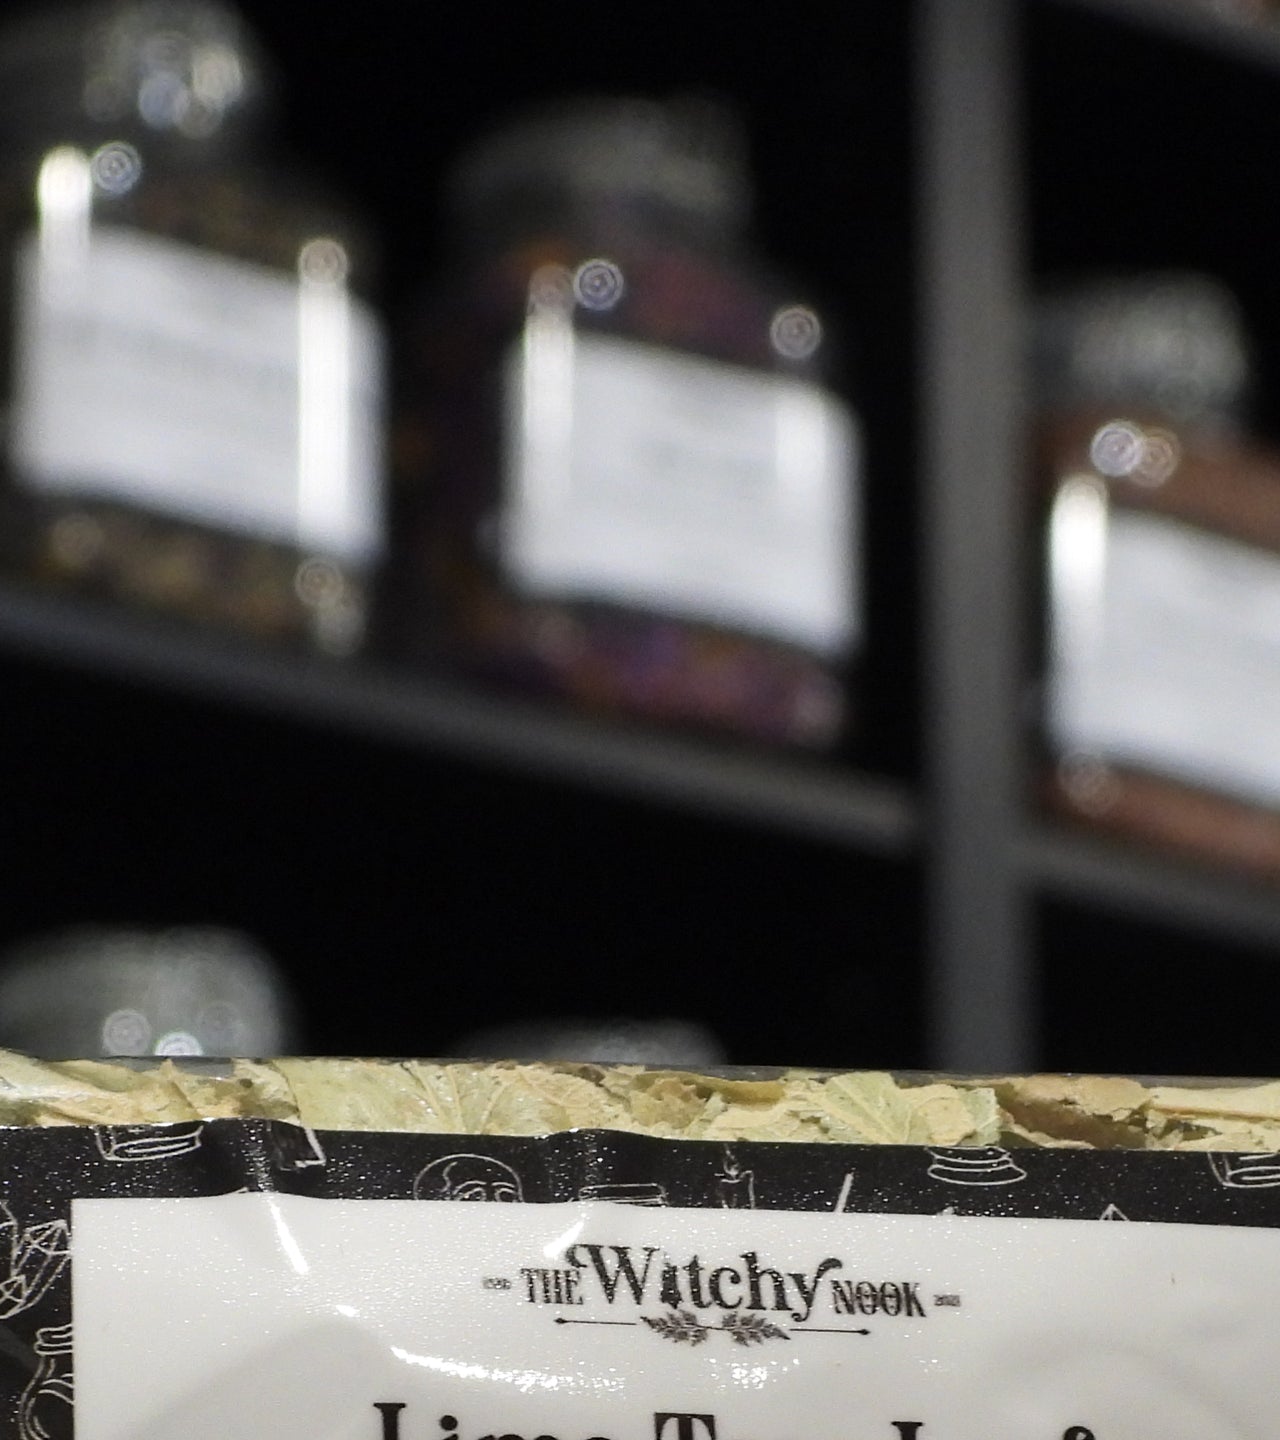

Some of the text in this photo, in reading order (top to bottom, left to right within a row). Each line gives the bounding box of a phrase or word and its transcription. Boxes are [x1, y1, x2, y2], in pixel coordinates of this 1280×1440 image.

[519, 1243, 927, 1322] THE Witchy NOOK
